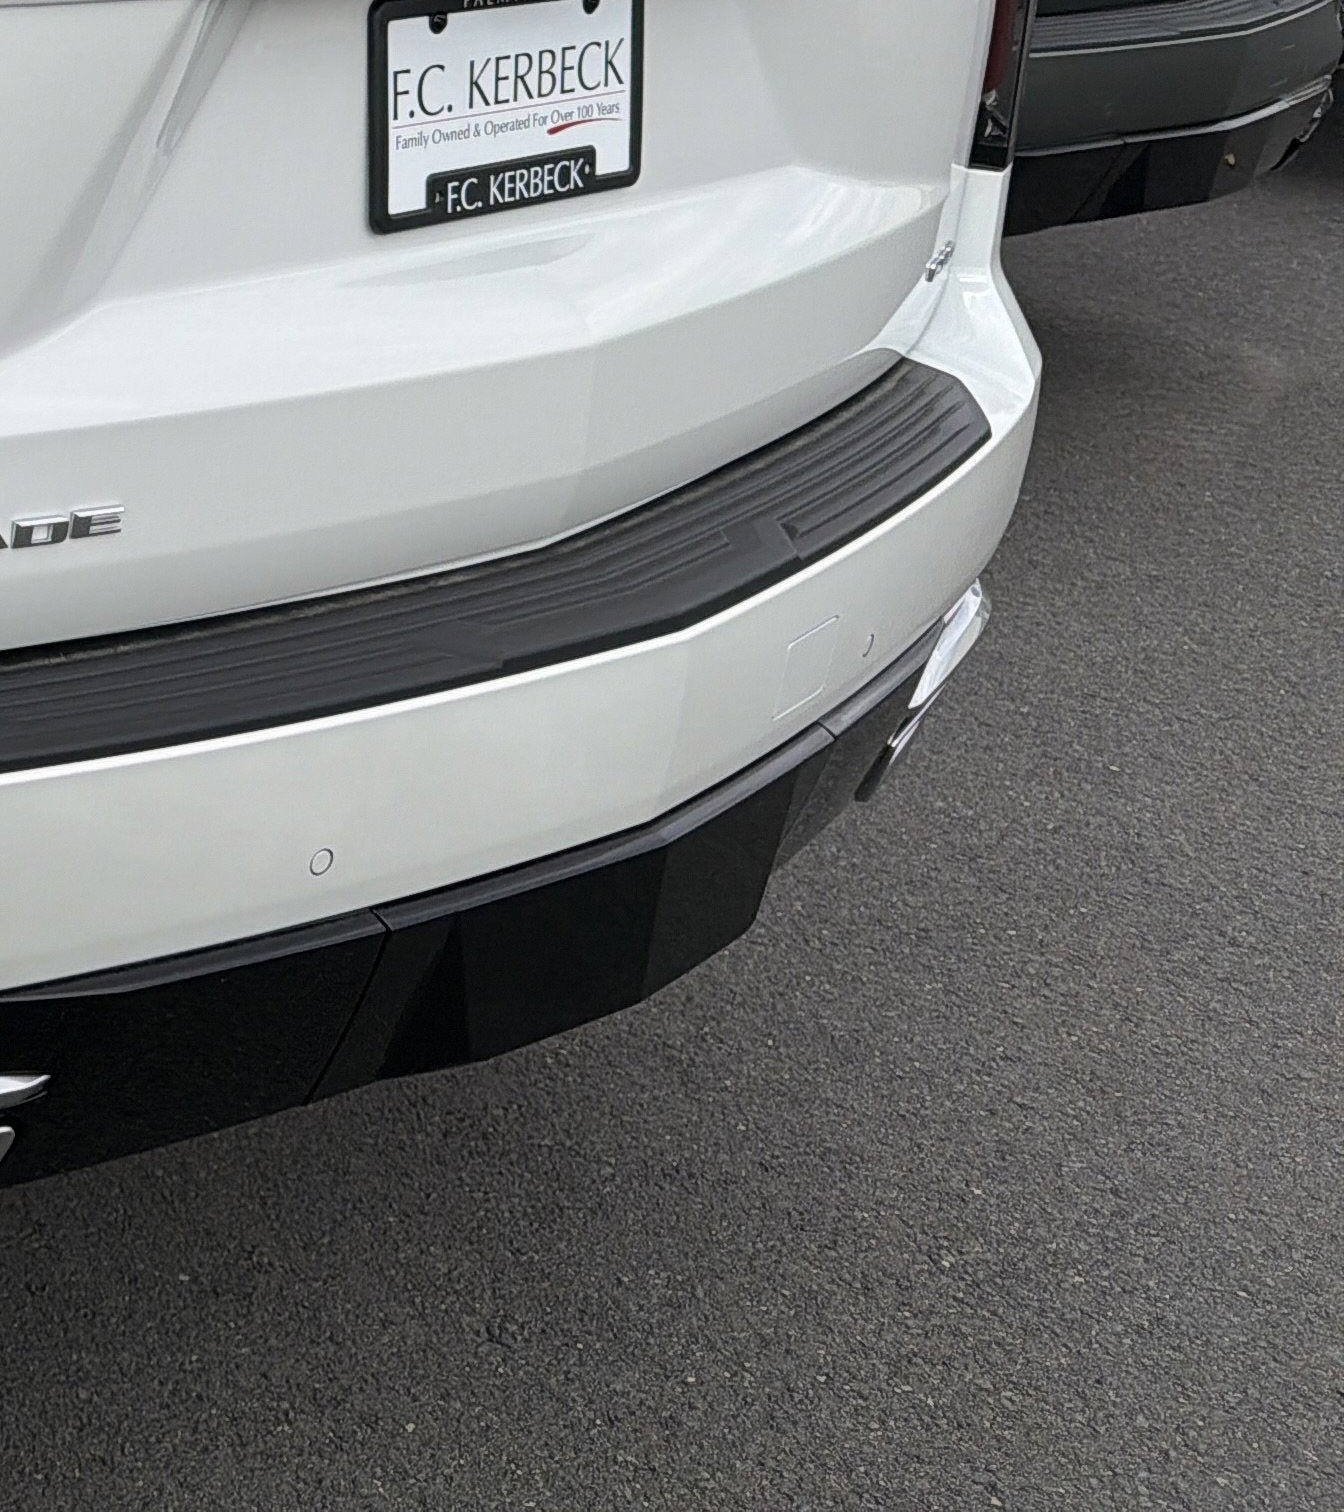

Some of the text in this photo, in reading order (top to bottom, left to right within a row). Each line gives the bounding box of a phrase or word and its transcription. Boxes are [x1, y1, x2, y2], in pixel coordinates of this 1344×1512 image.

[392, 38, 625, 121] F.C. KERBECK
[395, 102, 620, 150] Family Owned & Operated For Over 100 Years
[447, 158, 585, 214] F.C. KERBECK
